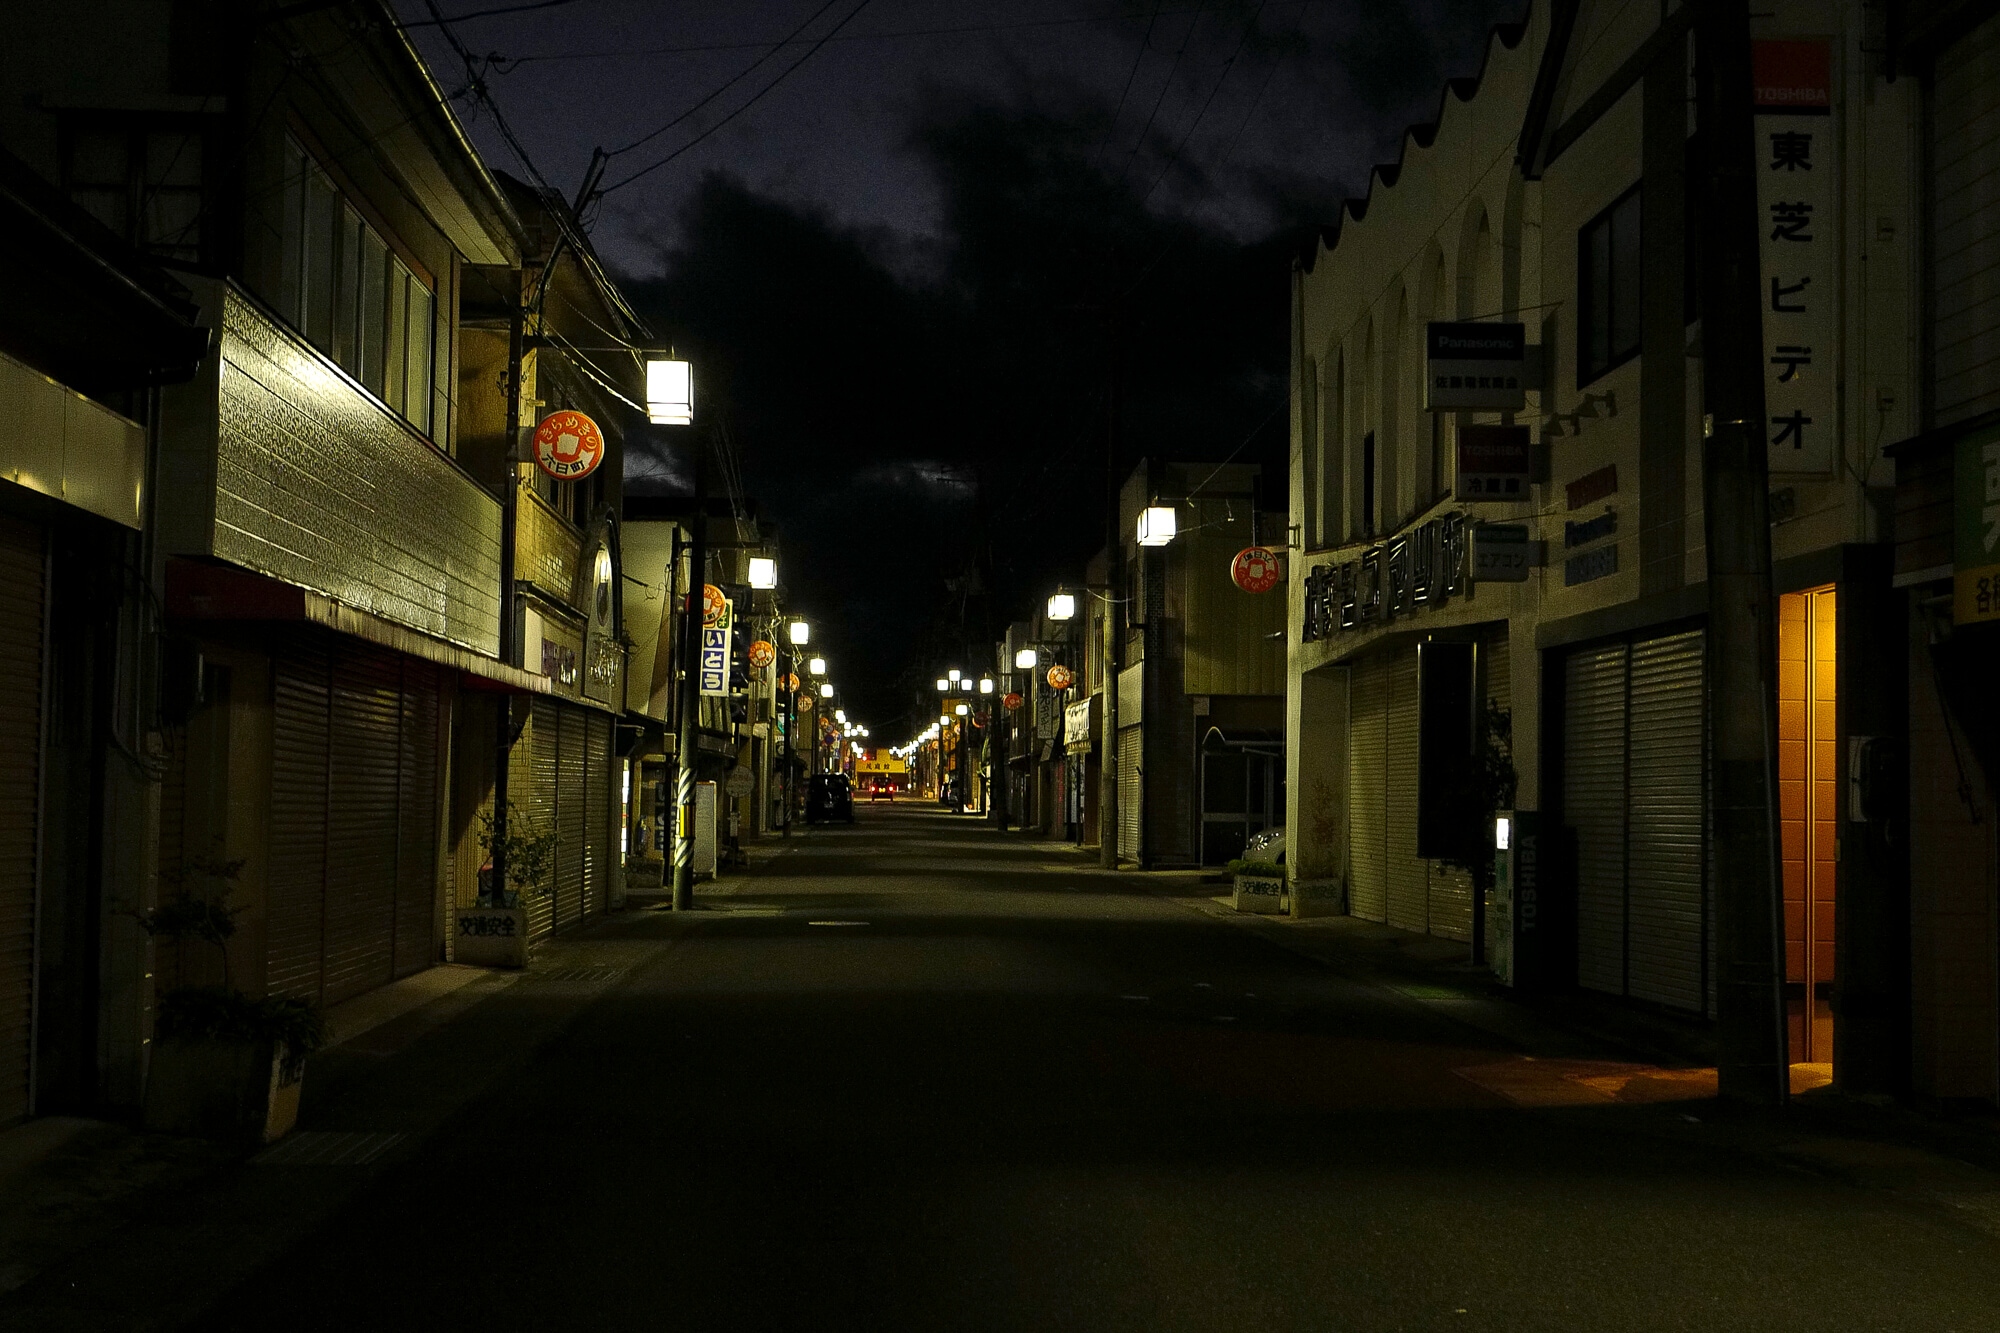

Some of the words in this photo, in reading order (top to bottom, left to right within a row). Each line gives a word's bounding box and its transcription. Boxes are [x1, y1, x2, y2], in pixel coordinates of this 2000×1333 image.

[1755, 87, 1827, 102] TOSHIBA
[1770, 131, 1813, 449] 東芝ビデオ
[1438, 335, 1516, 350] Panasonic
[540, 416, 598, 450] きらめきの
[1464, 444, 1524, 456] TOSHIBA
[542, 453, 585, 475] 六日町
[1468, 478, 1520, 493] 冷蔵庫
[1477, 553, 1525, 569] エアコン
[703, 631, 724, 691] いとう
[1520, 835, 1537, 933] TOSHIBA
[458, 916, 516, 937] 交通安全
